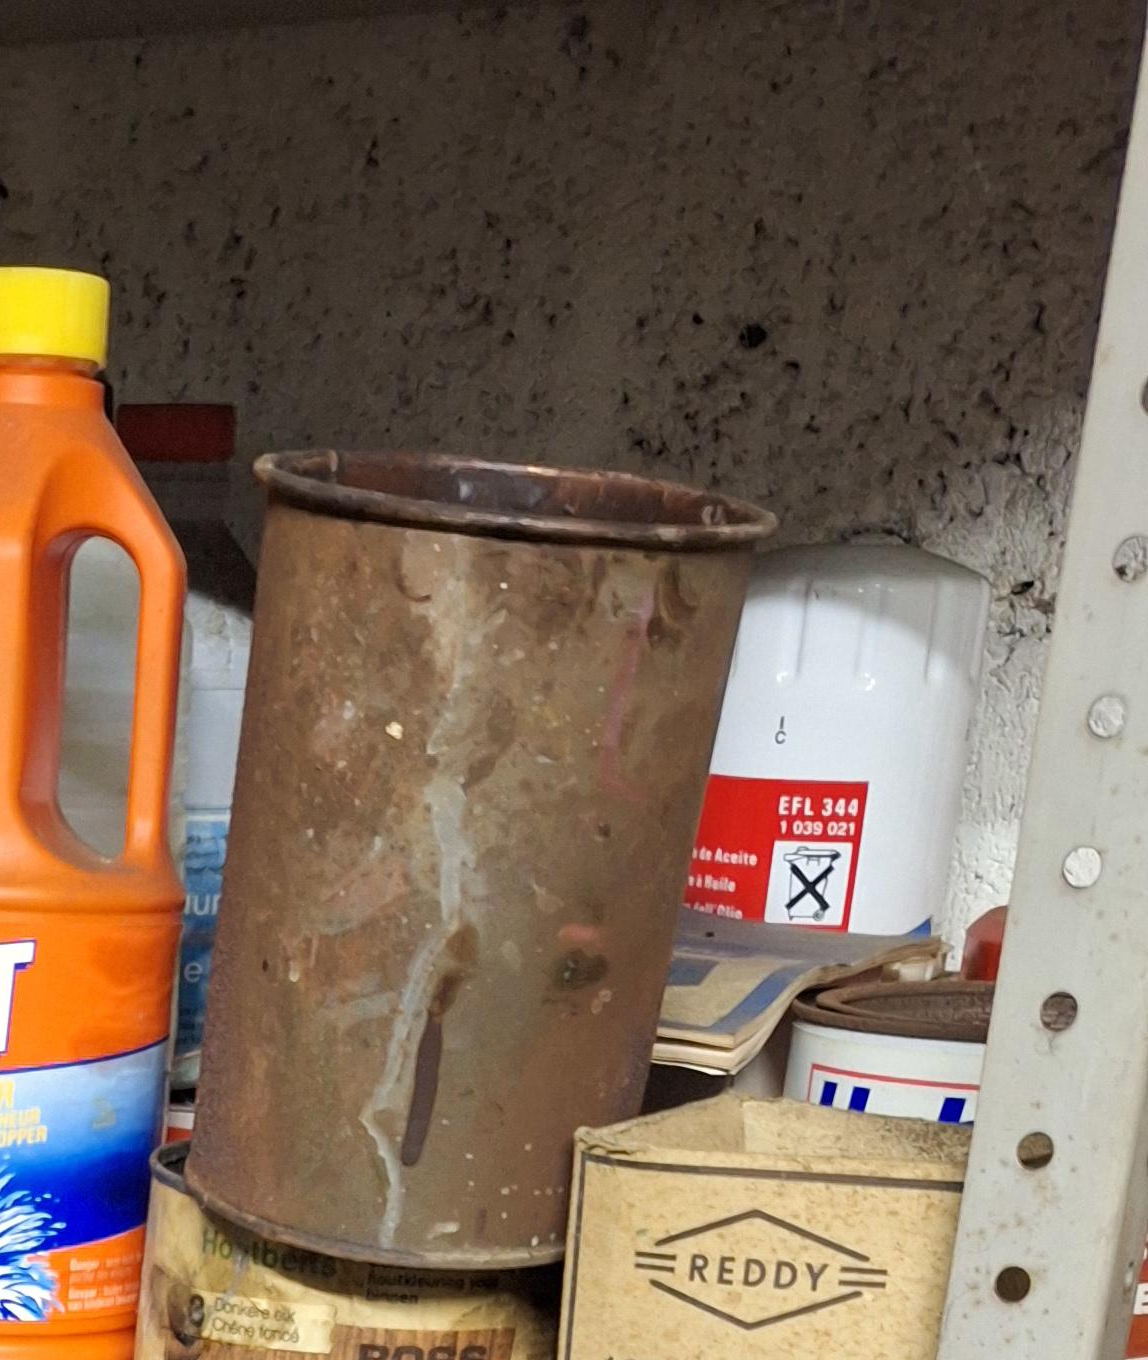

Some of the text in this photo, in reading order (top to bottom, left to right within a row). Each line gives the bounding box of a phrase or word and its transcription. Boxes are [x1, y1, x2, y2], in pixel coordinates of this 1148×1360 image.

[778, 796, 860, 817] EFL 344
[780, 820, 856, 836] 1 039 021
[714, 848, 758, 867] Aceite
[202, 1226, 338, 1278] Hotbeits
[688, 1253, 829, 1291] REDDY
